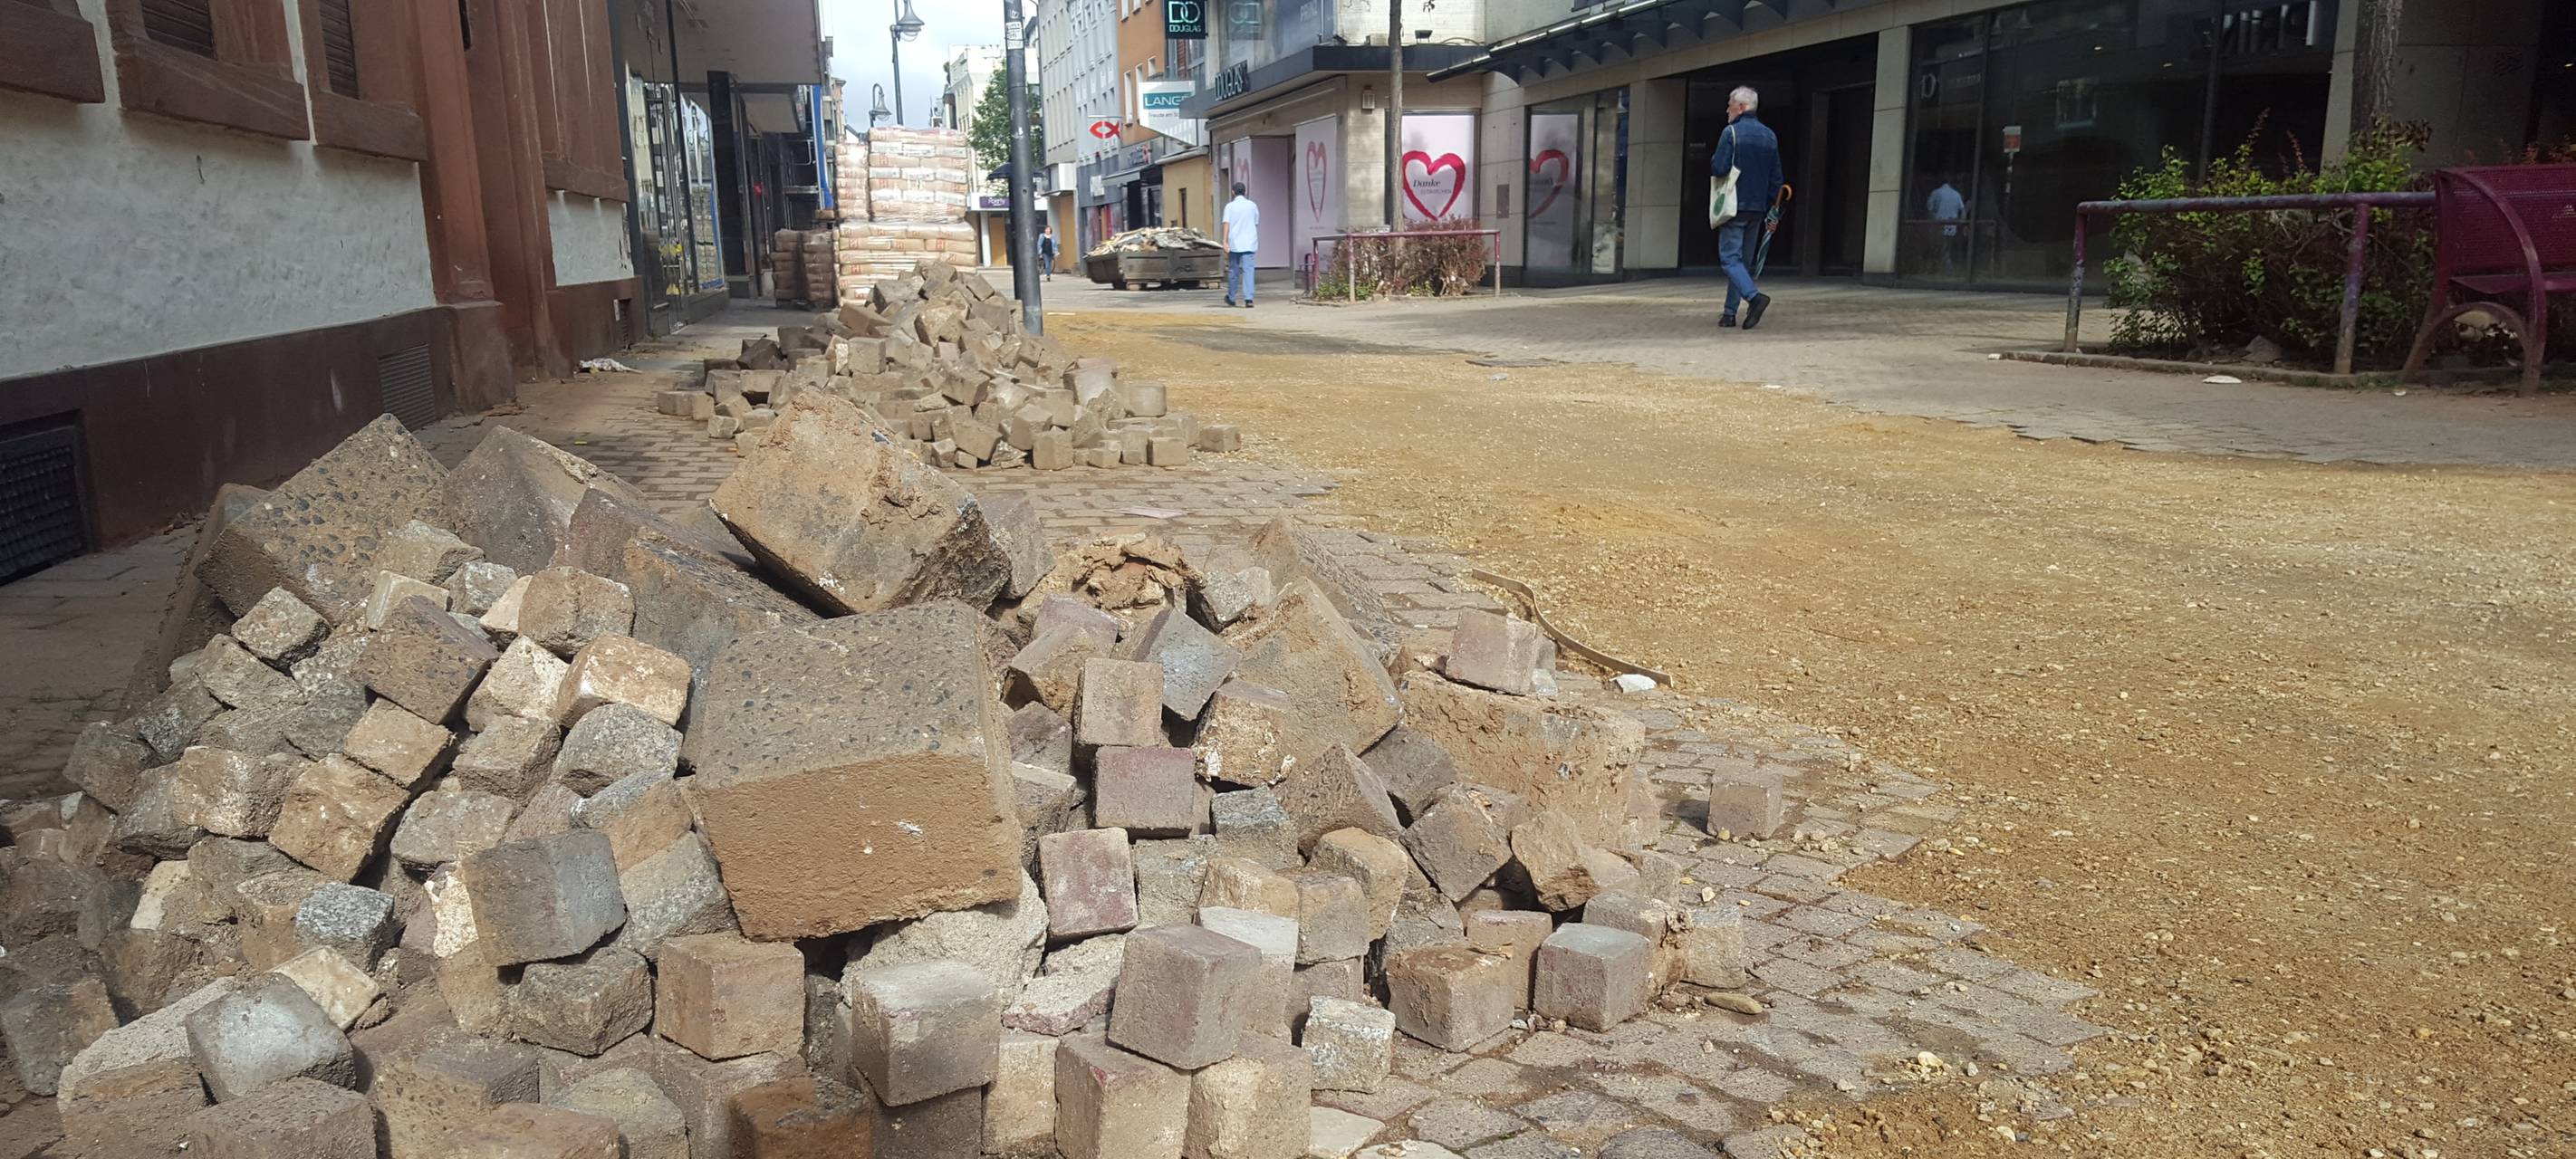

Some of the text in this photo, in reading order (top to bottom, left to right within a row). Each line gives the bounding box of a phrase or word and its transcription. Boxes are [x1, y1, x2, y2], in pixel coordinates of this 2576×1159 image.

[1168, 24, 1202, 33] DOUGLAS
[1144, 94, 1189, 107] LANG
[1413, 178, 1441, 187] Danke
